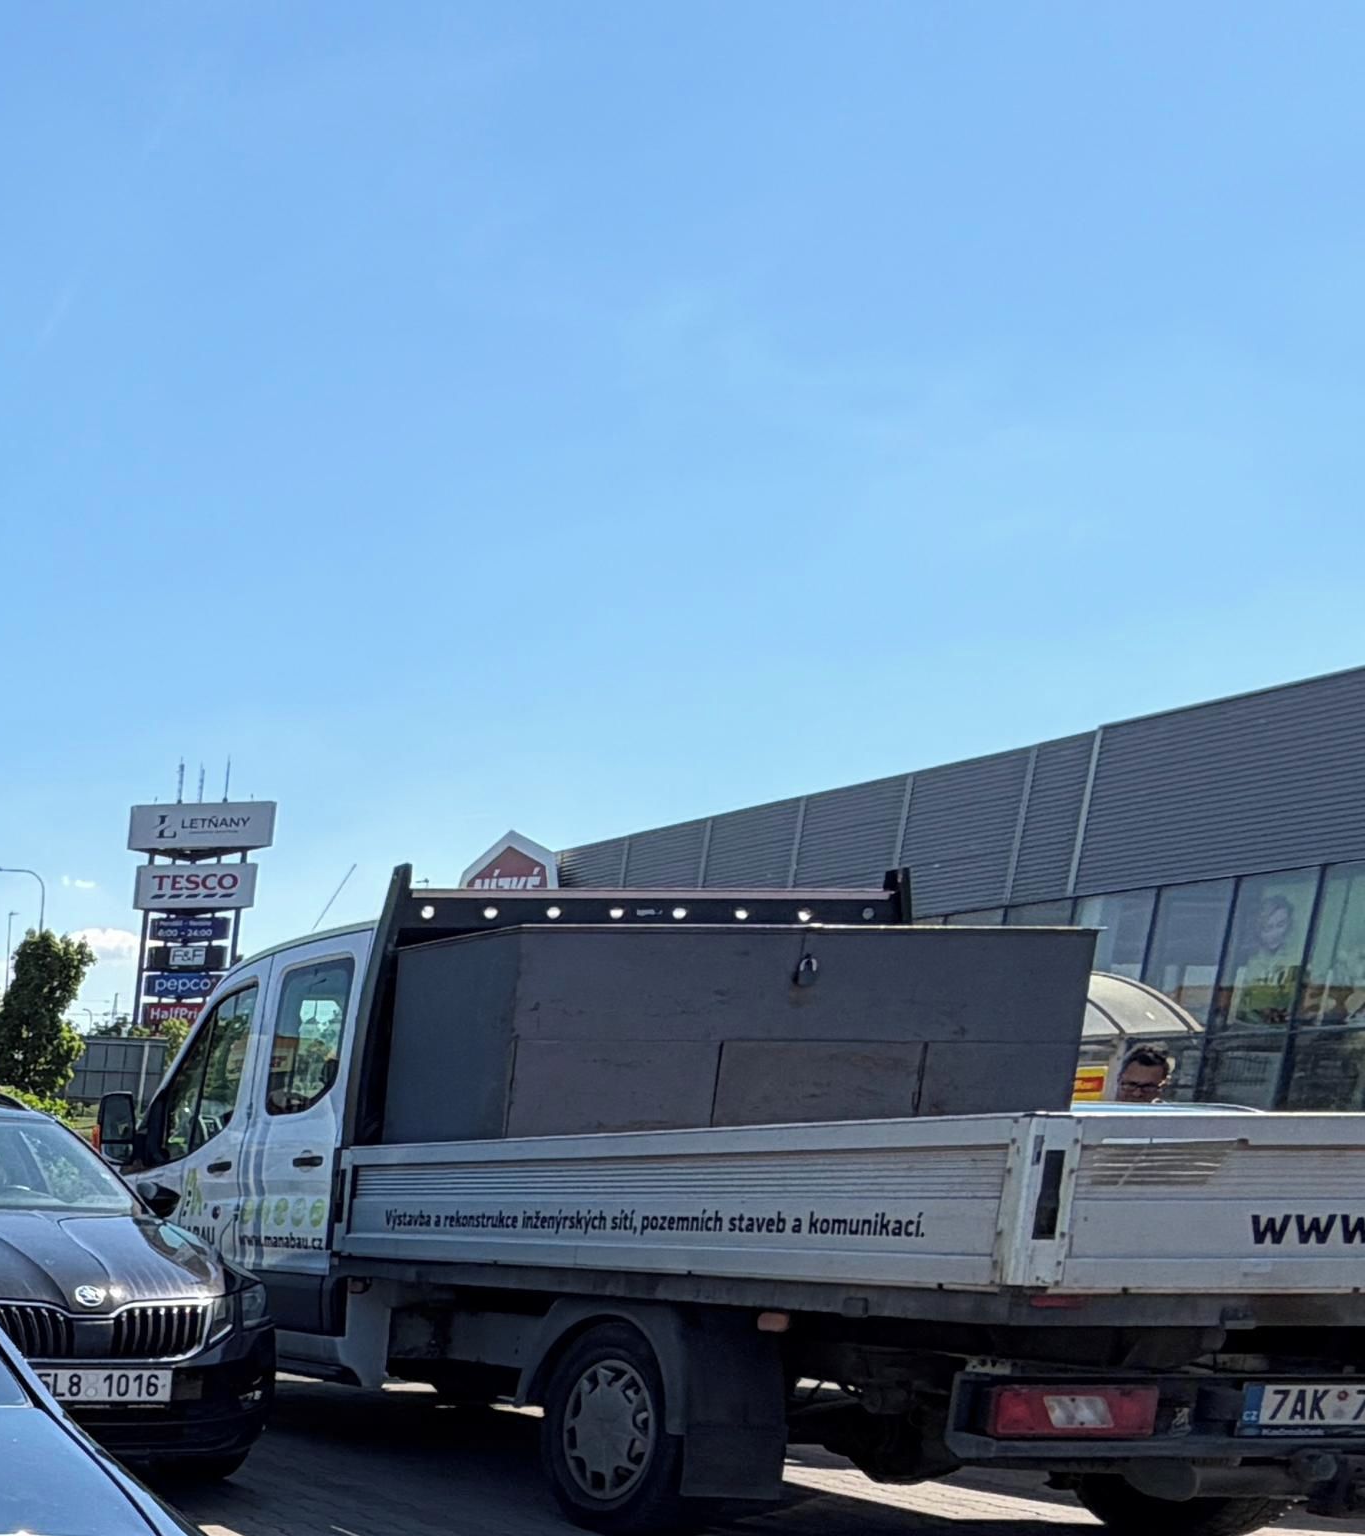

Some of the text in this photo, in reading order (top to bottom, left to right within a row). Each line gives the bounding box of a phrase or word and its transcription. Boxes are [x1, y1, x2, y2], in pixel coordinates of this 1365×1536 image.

[151, 872, 239, 891] TESCO
[154, 978, 212, 993] pepco
[150, 1007, 197, 1020] HalfPri
[385, 1209, 431, 1231] Výstavba
[434, 1213, 442, 1228] a
[443, 1209, 518, 1229] rekonstrukce
[521, 1209, 607, 1234] inženýrských
[640, 1209, 723, 1236] pozemních
[728, 1210, 787, 1234] staveb
[791, 1216, 802, 1234] a
[808, 1210, 925, 1238] komunikací.
[103, 1373, 160, 1397] 1016
[1269, 1389, 1331, 1420] 7AK
